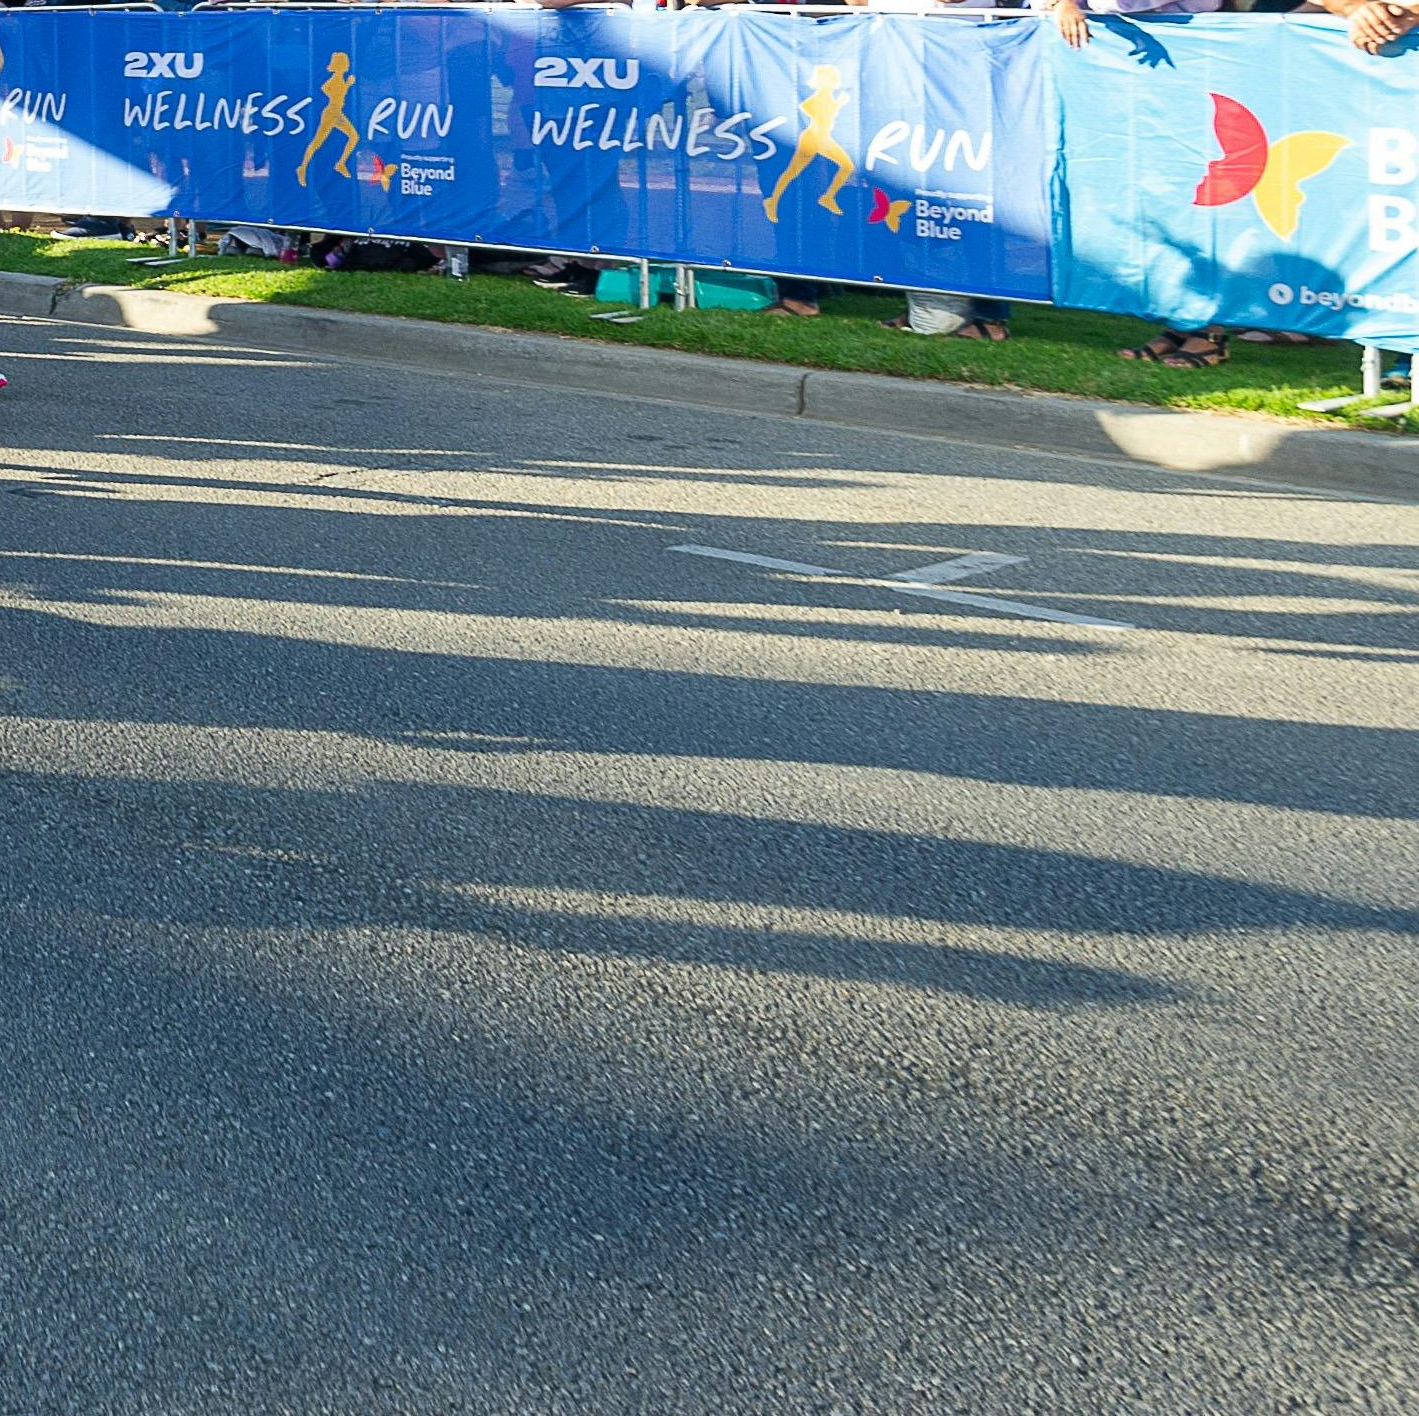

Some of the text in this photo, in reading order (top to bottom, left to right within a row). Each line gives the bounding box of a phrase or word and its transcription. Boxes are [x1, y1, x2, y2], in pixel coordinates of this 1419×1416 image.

[124, 51, 204, 79] 2XU
[534, 56, 640, 90] 2XU
[0, 87, 67, 126] RUN
[123, 90, 454, 141] WELLNESS RUN
[531, 103, 992, 173] WELLNESS RUN
[401, 163, 455, 183] Beyond
[401, 179, 433, 196] Blue
[916, 199, 994, 224] Beyond
[916, 219, 962, 241] Blue
